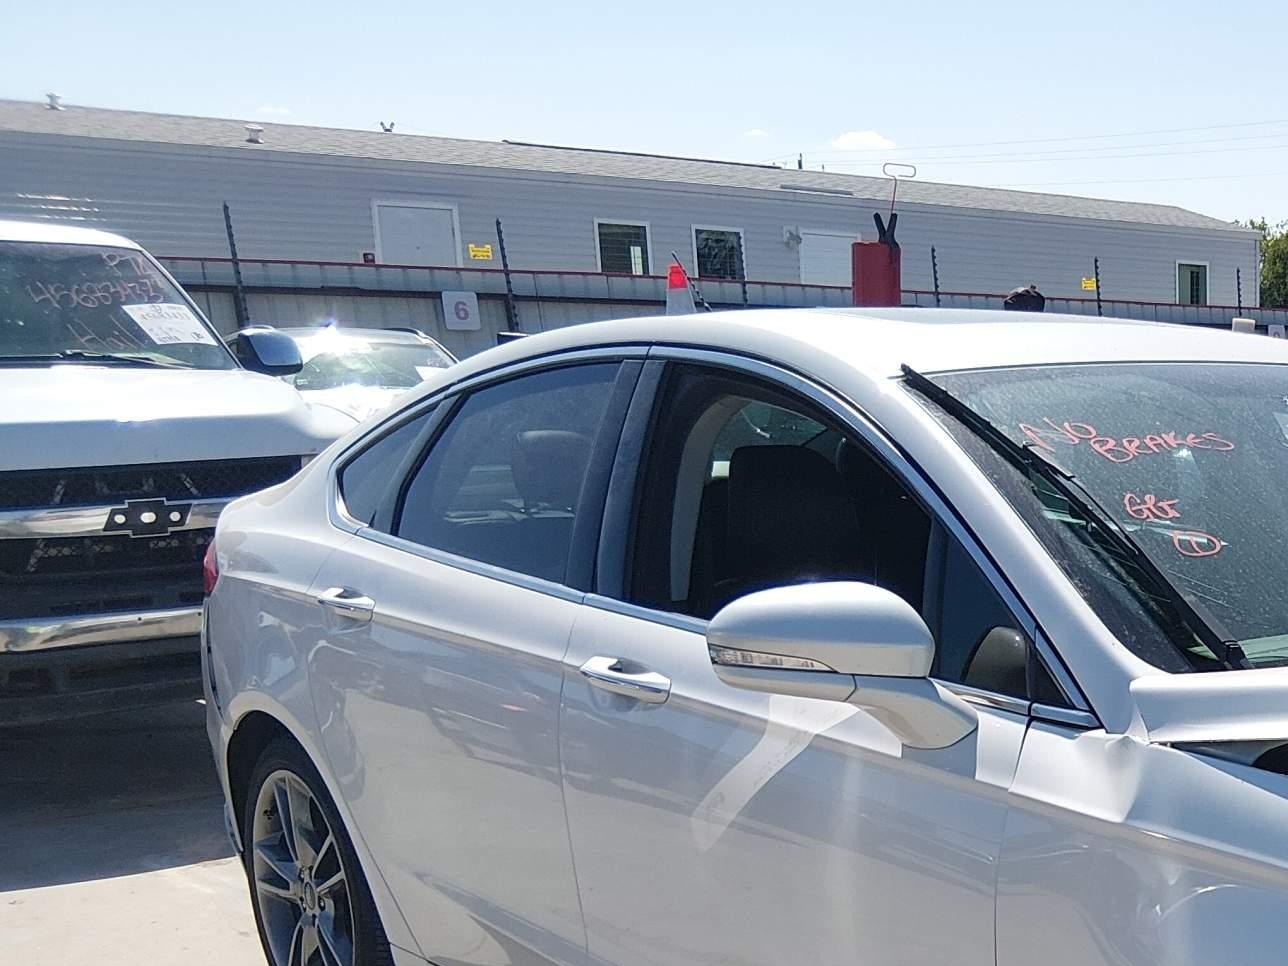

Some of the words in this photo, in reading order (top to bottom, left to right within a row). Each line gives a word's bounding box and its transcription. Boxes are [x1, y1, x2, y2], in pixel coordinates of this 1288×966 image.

[454, 301, 470, 321] 6
[1017, 416, 1097, 453] NO
[1090, 430, 1235, 464] BRAKES
